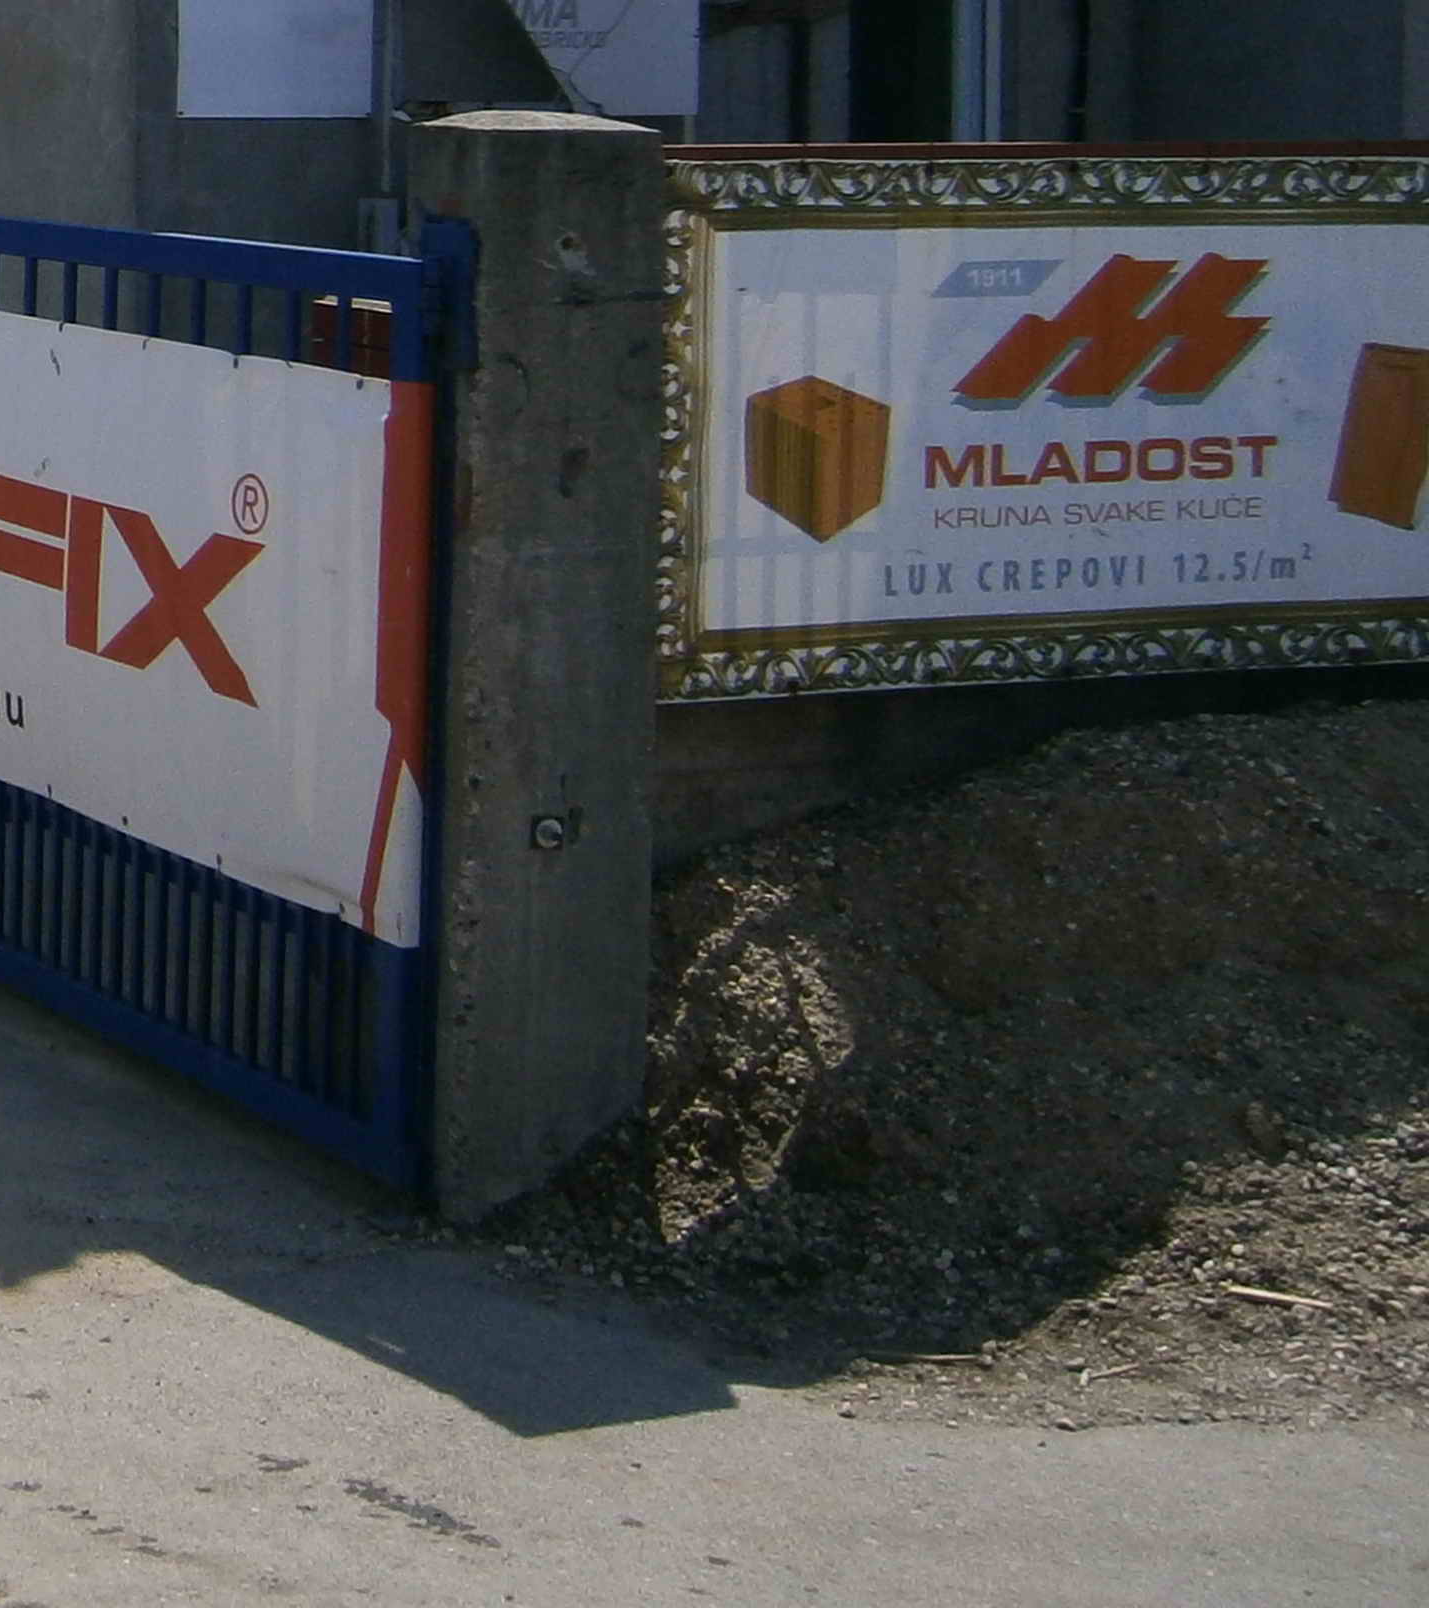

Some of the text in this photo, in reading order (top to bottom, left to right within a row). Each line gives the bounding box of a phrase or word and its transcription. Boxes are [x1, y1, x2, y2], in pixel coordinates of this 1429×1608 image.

[966, 266, 1022, 288] 1911
[924, 435, 1278, 490] MLADOST
[933, 504, 1052, 530] KRUNA
[1063, 499, 1165, 525] SVAKE
[884, 562, 953, 596] LUX
[978, 556, 1146, 592] CREPOVI
